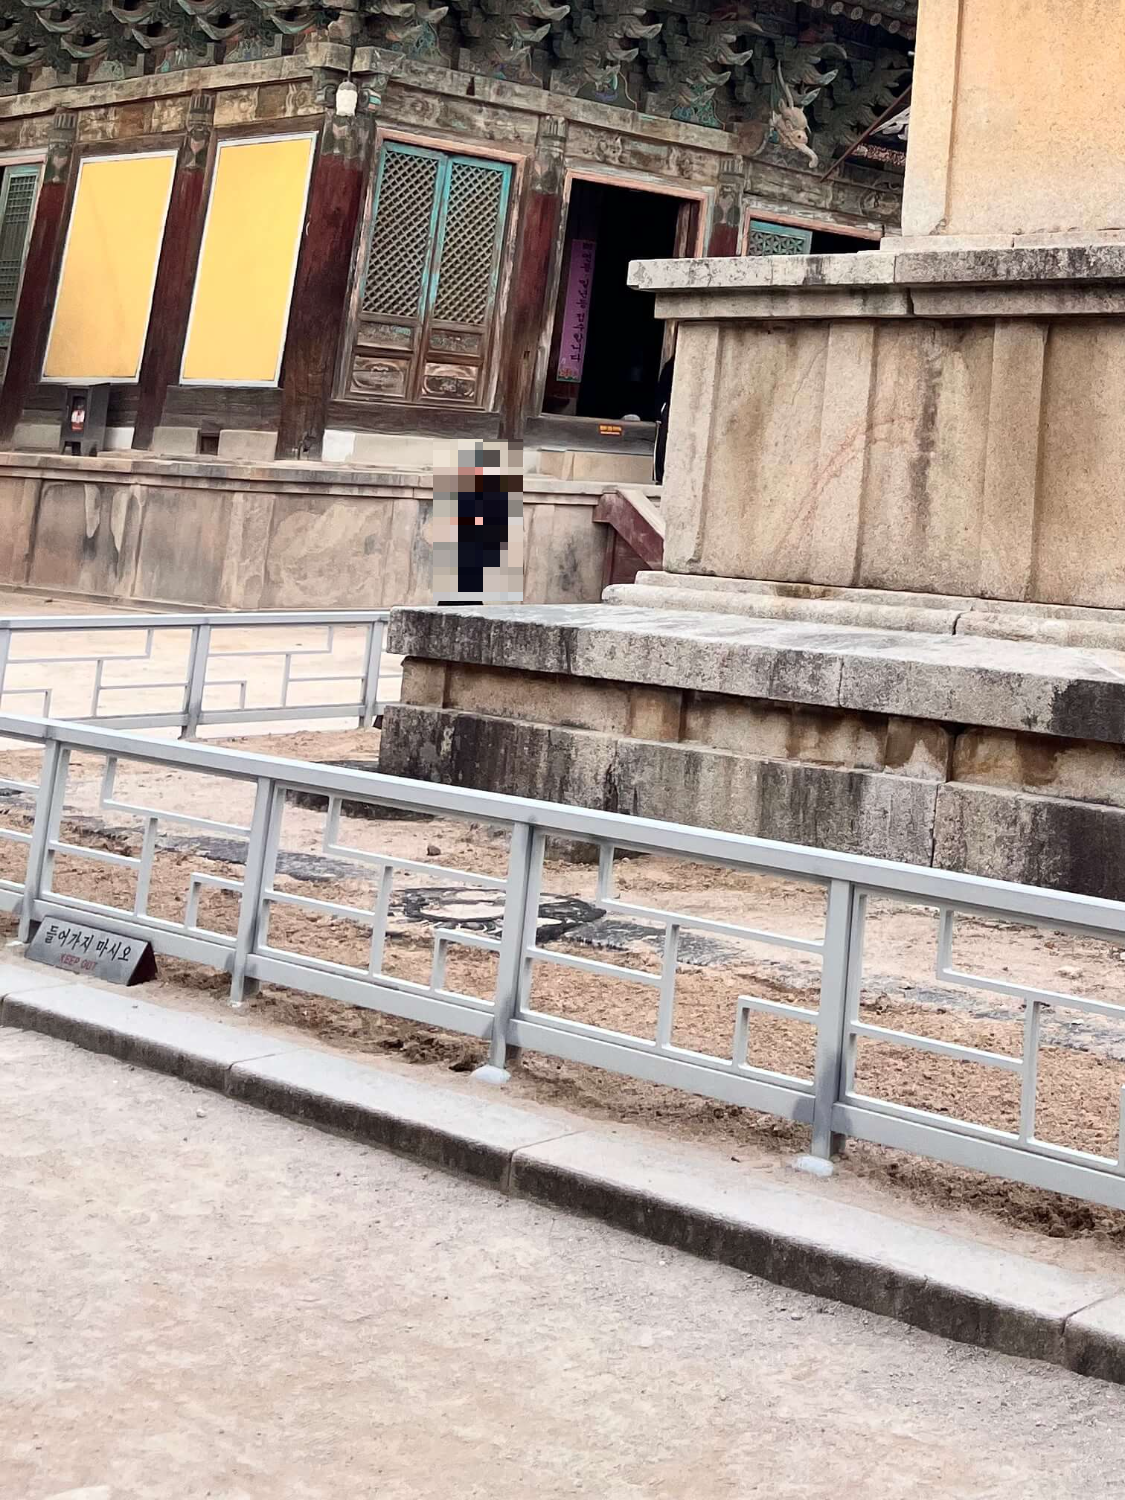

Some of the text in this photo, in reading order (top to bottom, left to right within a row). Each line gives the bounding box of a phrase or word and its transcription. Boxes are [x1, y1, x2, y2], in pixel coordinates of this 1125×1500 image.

[44, 925, 132, 962] 들어가지 마시오
[59, 953, 98, 971] KEEP OUT
